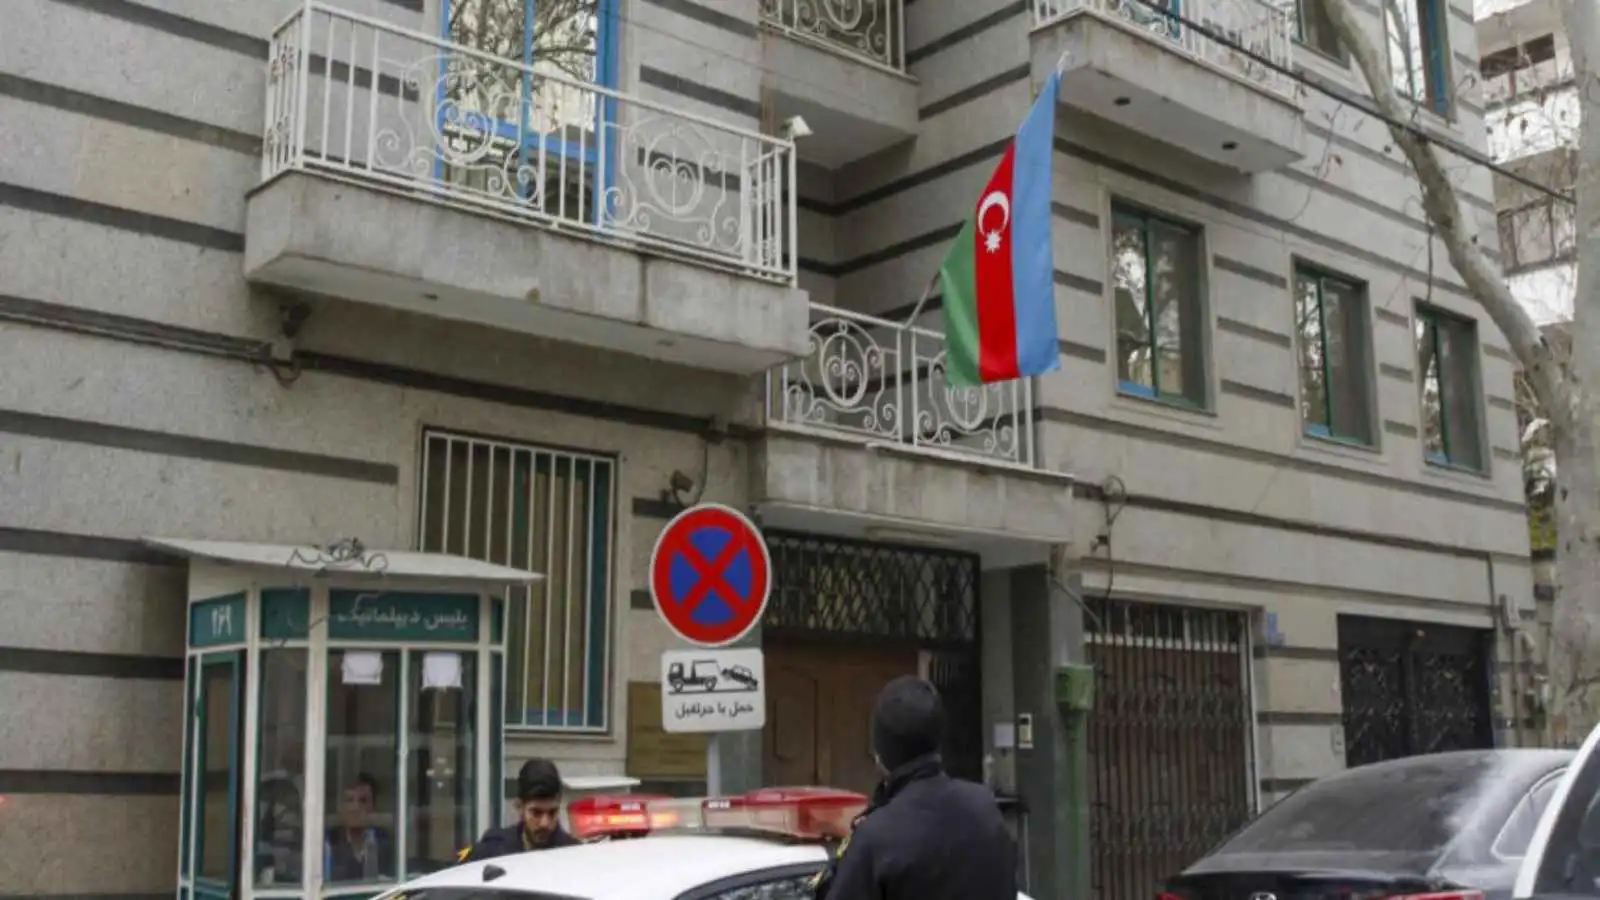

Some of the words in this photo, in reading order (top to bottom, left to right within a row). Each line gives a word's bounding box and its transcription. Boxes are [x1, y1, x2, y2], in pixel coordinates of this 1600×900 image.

[423, 608, 468, 631] پلیس
[674, 701, 714, 719] جرثقیل
[717, 701, 726, 716] با
[729, 701, 754, 718] حمل
